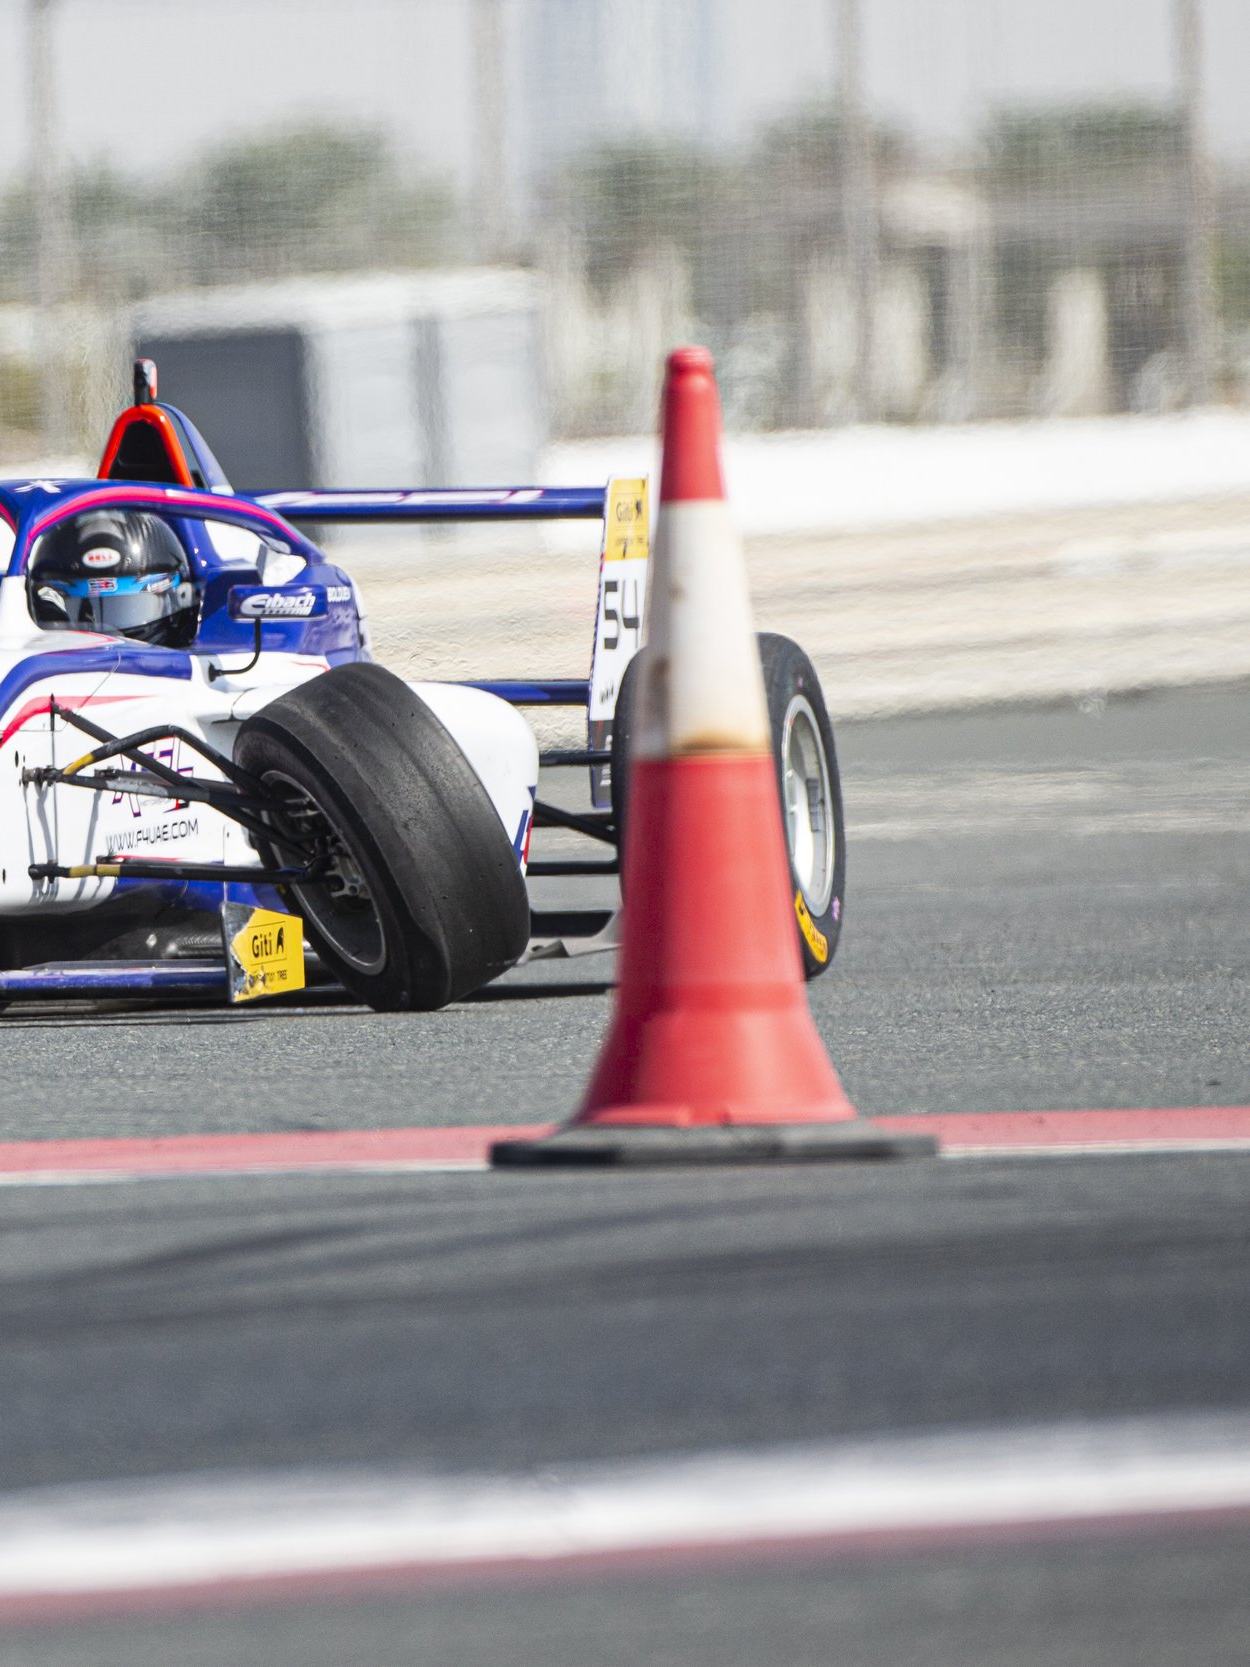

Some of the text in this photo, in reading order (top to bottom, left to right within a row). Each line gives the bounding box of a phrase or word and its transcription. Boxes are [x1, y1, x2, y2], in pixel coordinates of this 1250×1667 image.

[239, 592, 316, 616] Eibach
[604, 579, 639, 649] 54
[106, 819, 199, 853] WWW.F4UAE.COM
[252, 932, 272, 958] Giti
